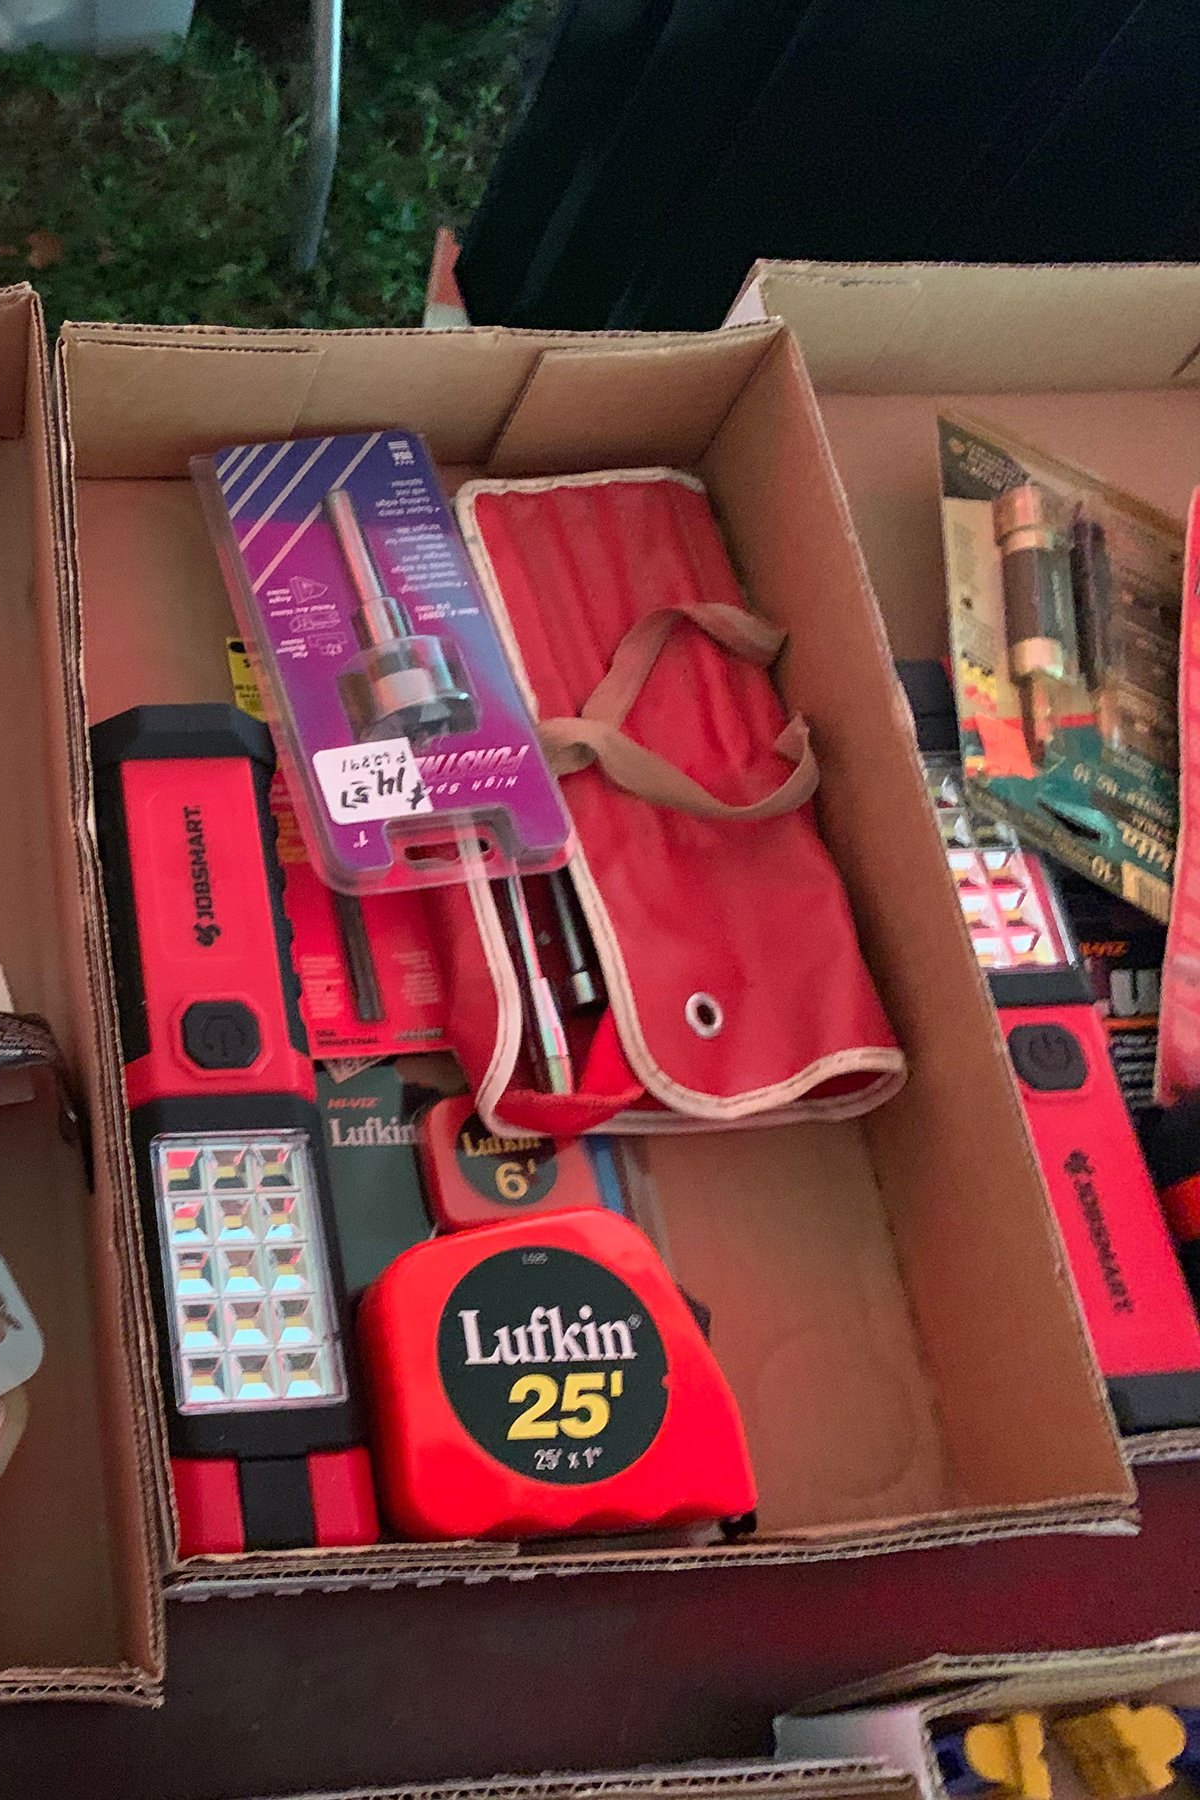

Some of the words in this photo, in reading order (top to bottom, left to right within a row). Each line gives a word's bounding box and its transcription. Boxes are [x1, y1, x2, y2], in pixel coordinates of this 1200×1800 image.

[469, 772, 518, 792] High
[183, 805, 214, 920] JOBSMART
[328, 1116, 418, 1147] Lufkin
[495, 1160, 537, 1200] 6'
[1072, 1174, 1133, 1314] JOBSMART
[507, 1370, 624, 1441] 25'
[568, 1453, 579, 1469] x
